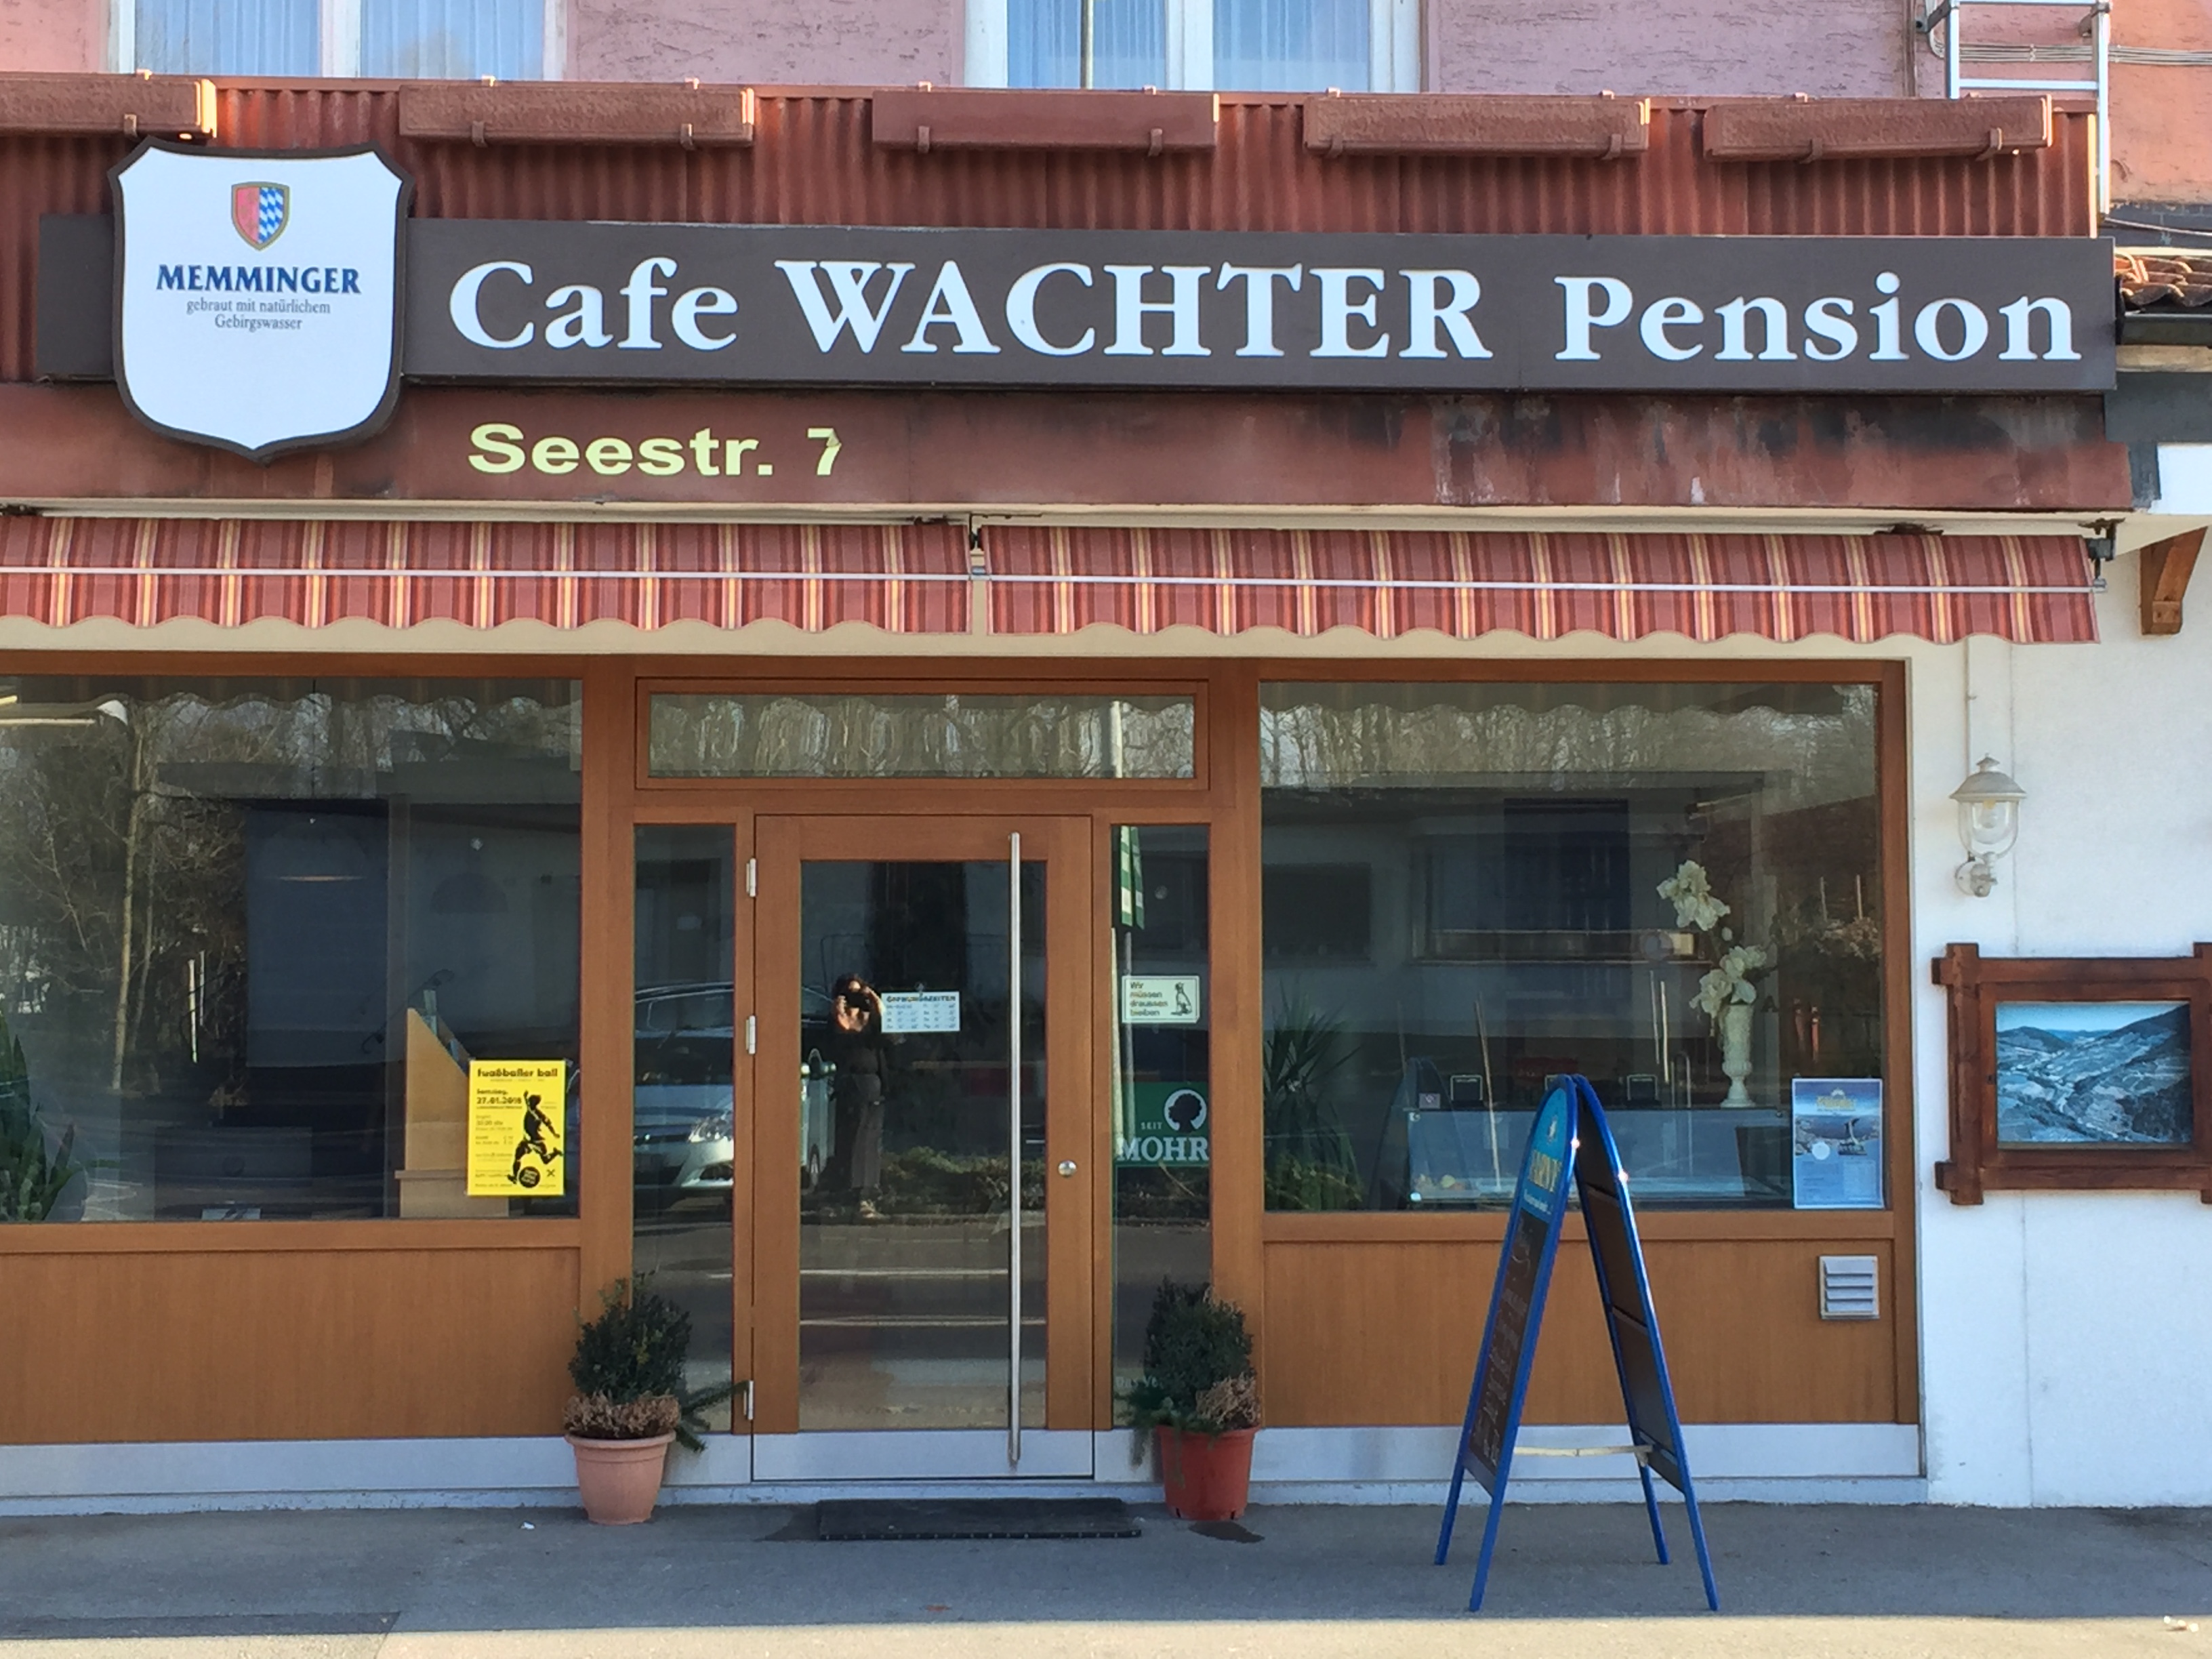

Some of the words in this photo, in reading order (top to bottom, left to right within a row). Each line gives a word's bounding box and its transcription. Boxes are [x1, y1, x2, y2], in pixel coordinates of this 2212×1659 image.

[156, 264, 362, 294] MEMMINGER
[186, 297, 232, 315] gebraut
[236, 298, 256, 312] mit
[259, 298, 331, 314] natürlichem
[449, 256, 739, 351] Cafe
[774, 259, 1494, 359] WACHTER
[1553, 271, 2082, 362] Pension
[214, 313, 303, 332] Gebirgswasser
[468, 423, 774, 476] Seestr.
[806, 427, 842, 476] 7
[537, 1068, 558, 1078] ball
[1141, 1122, 1162, 1130] SEIT
[1115, 1136, 1210, 1162] MOHR
